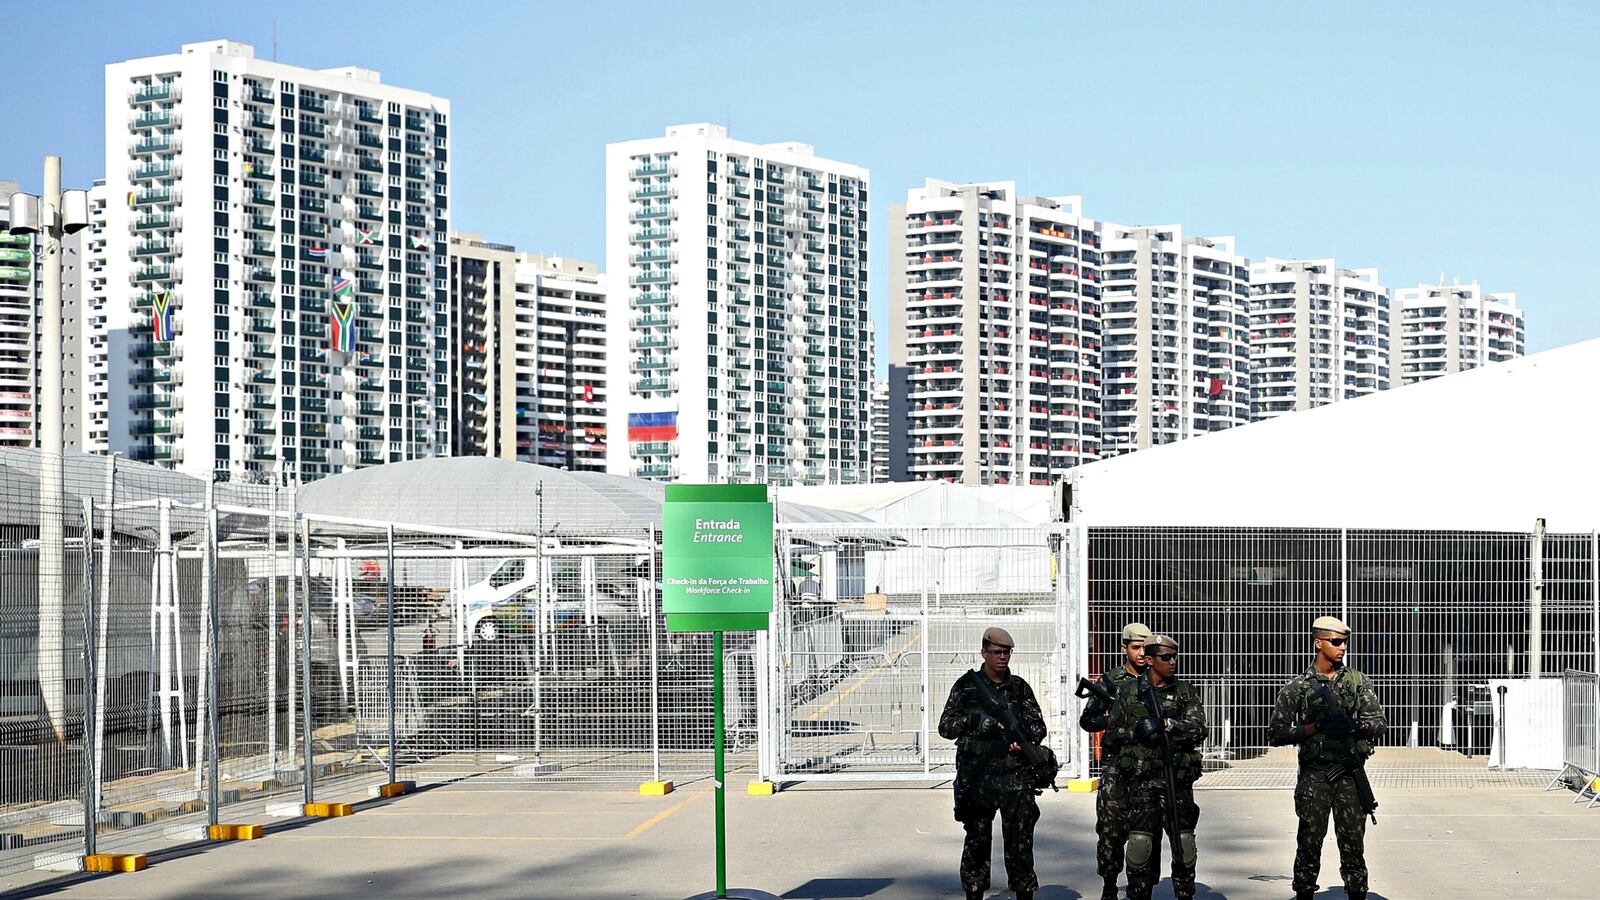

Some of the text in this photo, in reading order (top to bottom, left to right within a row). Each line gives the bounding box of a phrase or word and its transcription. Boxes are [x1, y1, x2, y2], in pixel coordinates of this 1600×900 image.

[695, 518, 741, 530] Entrada
[693, 531, 743, 543] Entrance
[667, 577, 769, 586] Check-in da Força de Trabalho
[686, 586, 751, 596] Workforce Check-in
